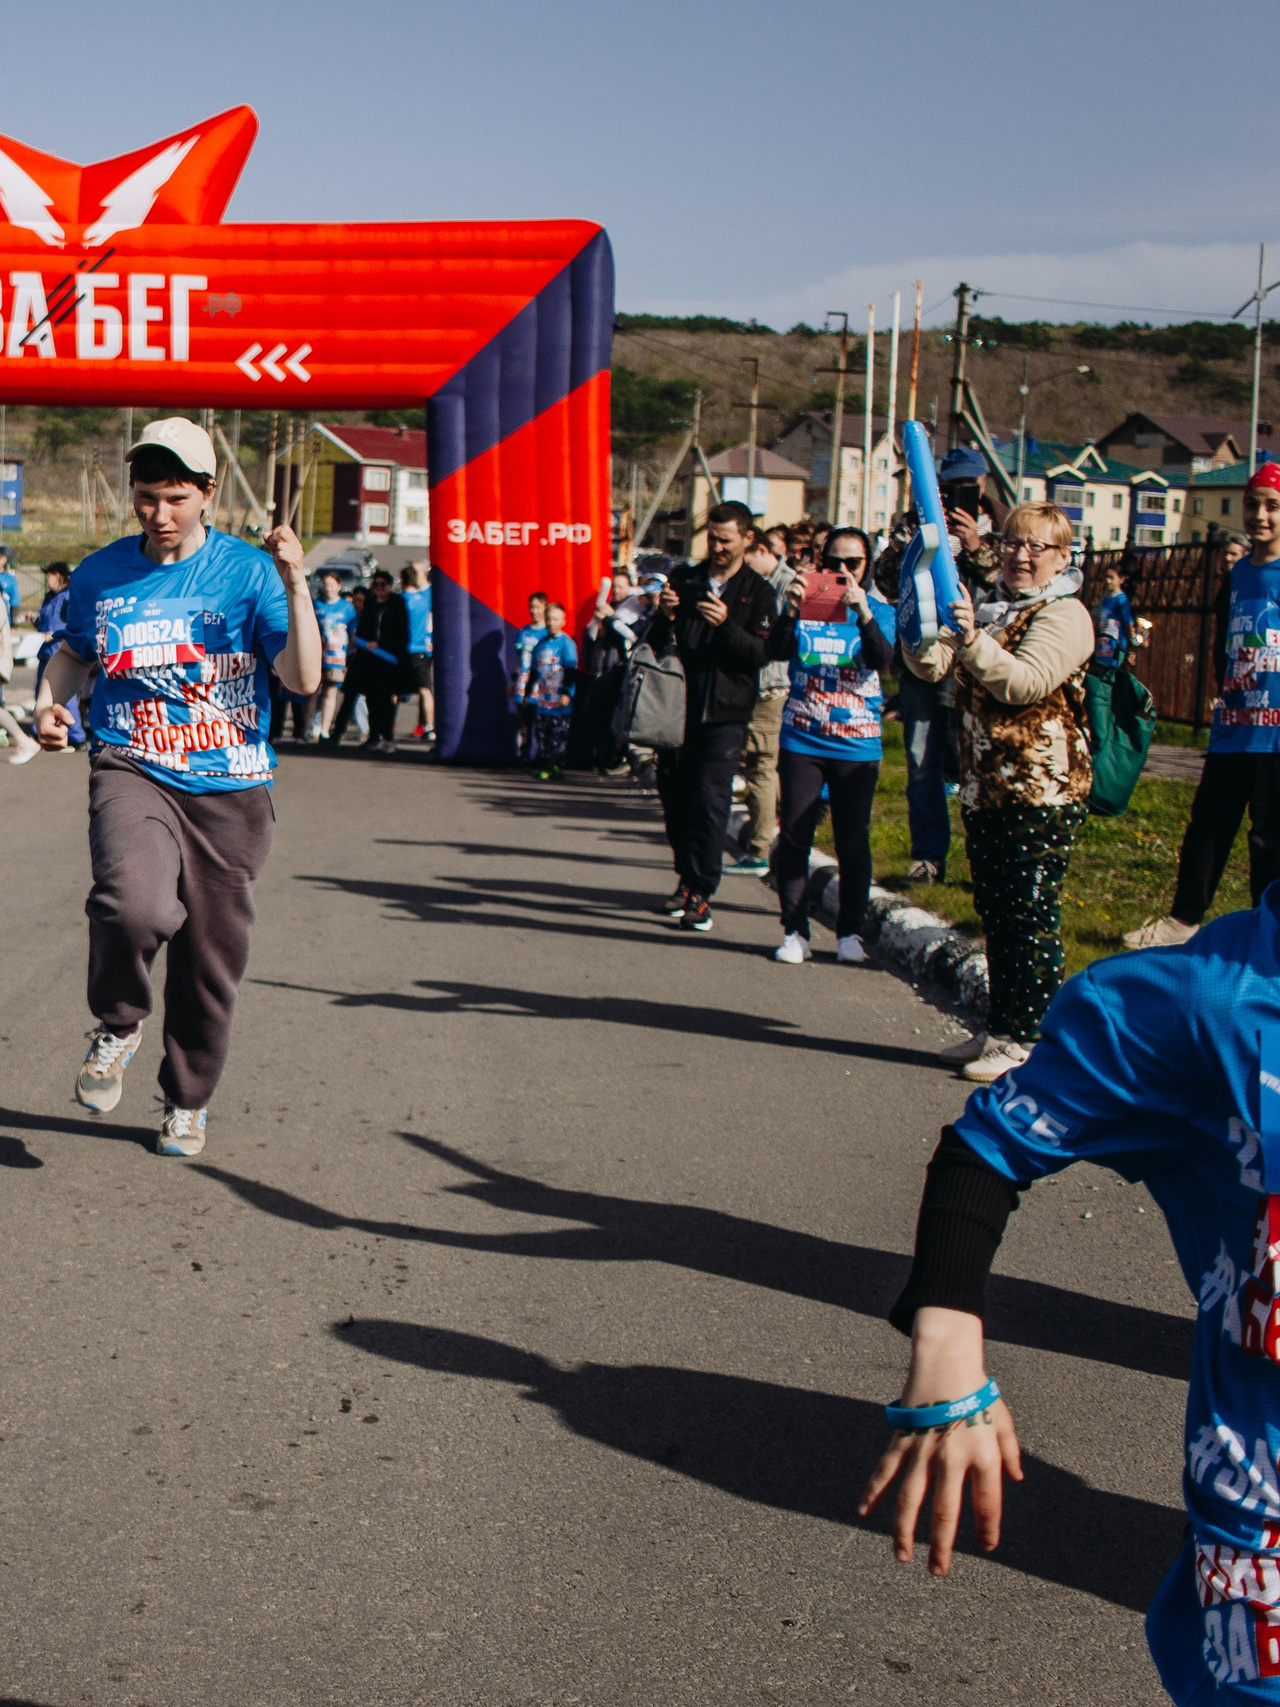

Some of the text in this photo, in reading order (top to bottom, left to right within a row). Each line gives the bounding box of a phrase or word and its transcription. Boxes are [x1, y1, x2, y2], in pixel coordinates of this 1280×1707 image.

[447, 518, 592, 546] ЗАБЕГ.РФ
[122, 618, 187, 648] 00524
[132, 643, 178, 668] 500М
[128, 718, 248, 755] #ГОРДОСТЬ
[226, 741, 271, 775] 2024
